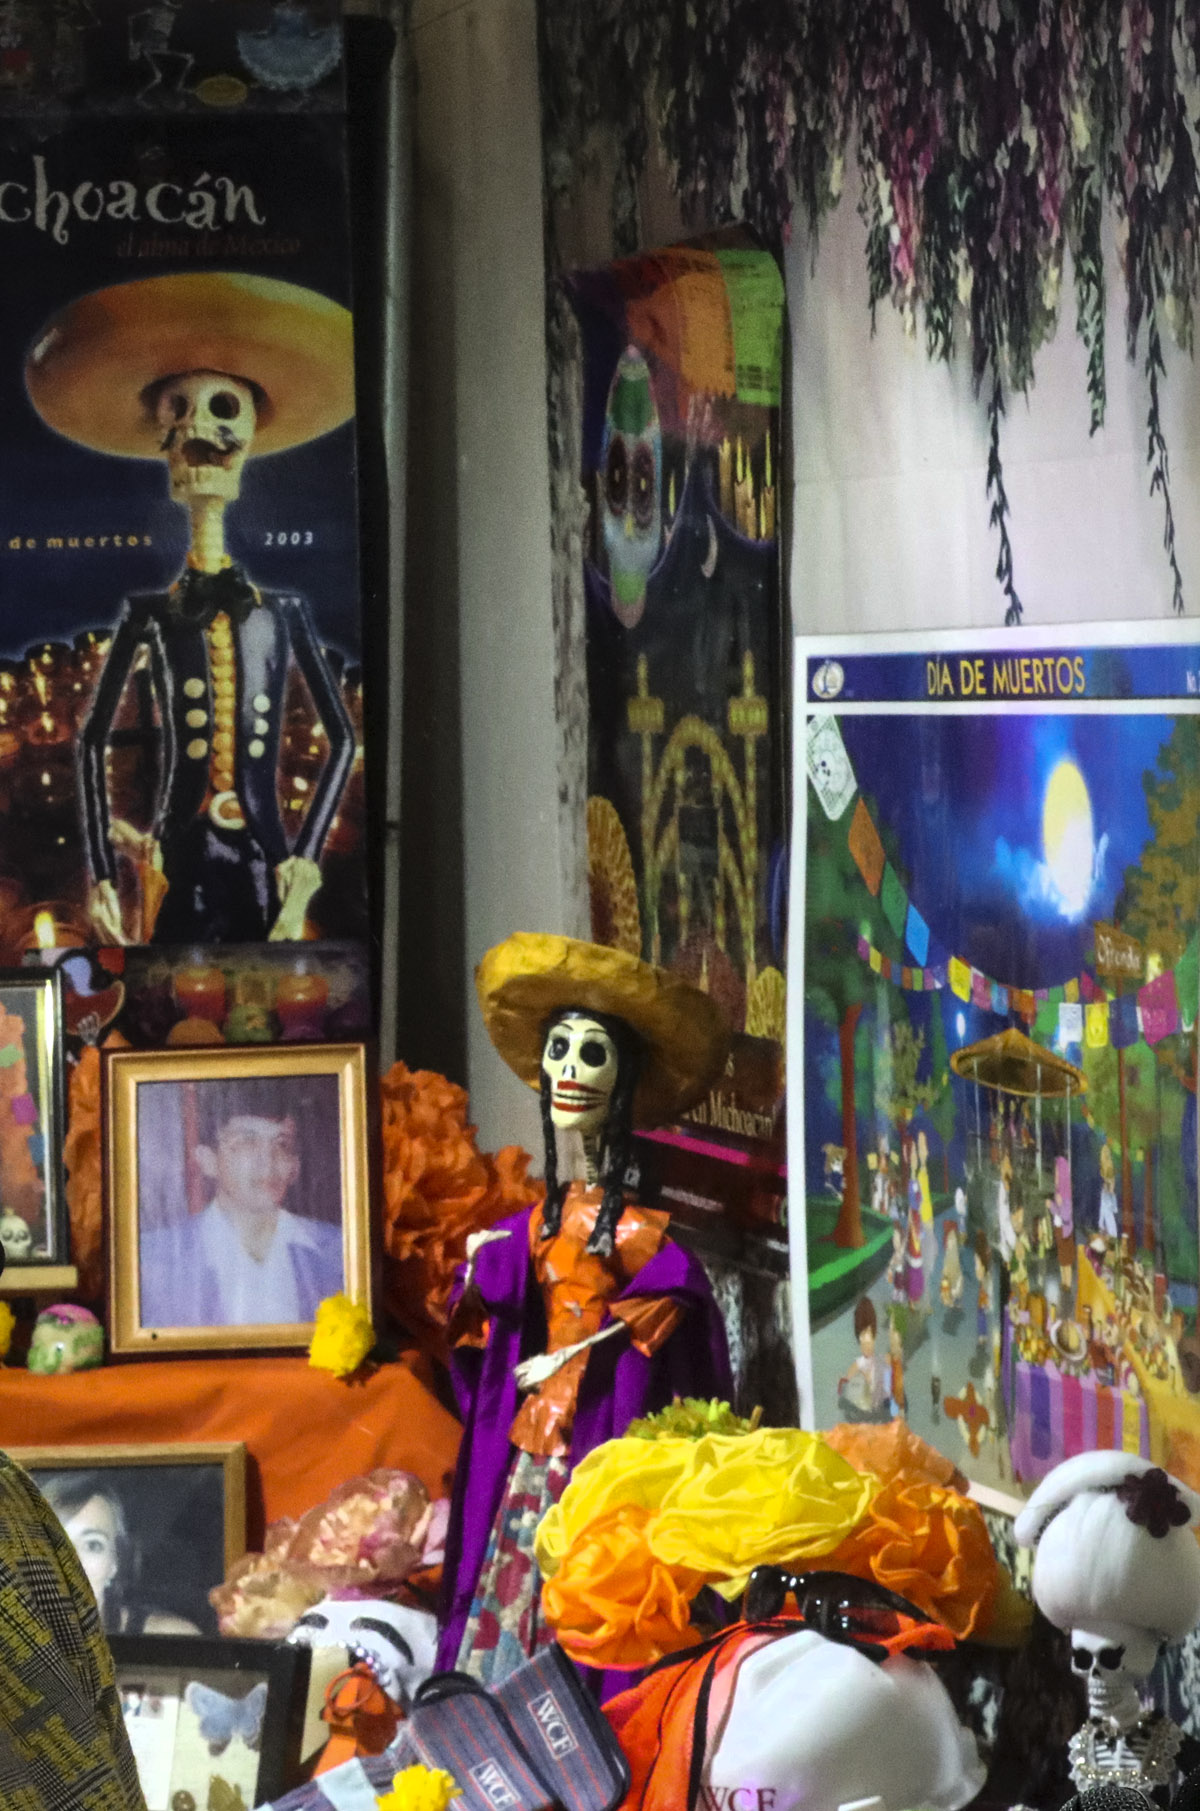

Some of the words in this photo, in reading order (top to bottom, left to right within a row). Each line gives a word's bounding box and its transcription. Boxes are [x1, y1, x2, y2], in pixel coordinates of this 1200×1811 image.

[8, 535, 37, 550] de
[47, 531, 153, 549] muertos
[264, 531, 314, 546] 2003
[960, 659, 987, 695] DE
[993, 656, 1086, 695] MUERTOS
[536, 1697, 572, 1751] WCF
[477, 1762, 515, 1808] WCF
[699, 1784, 776, 1811] WCF
